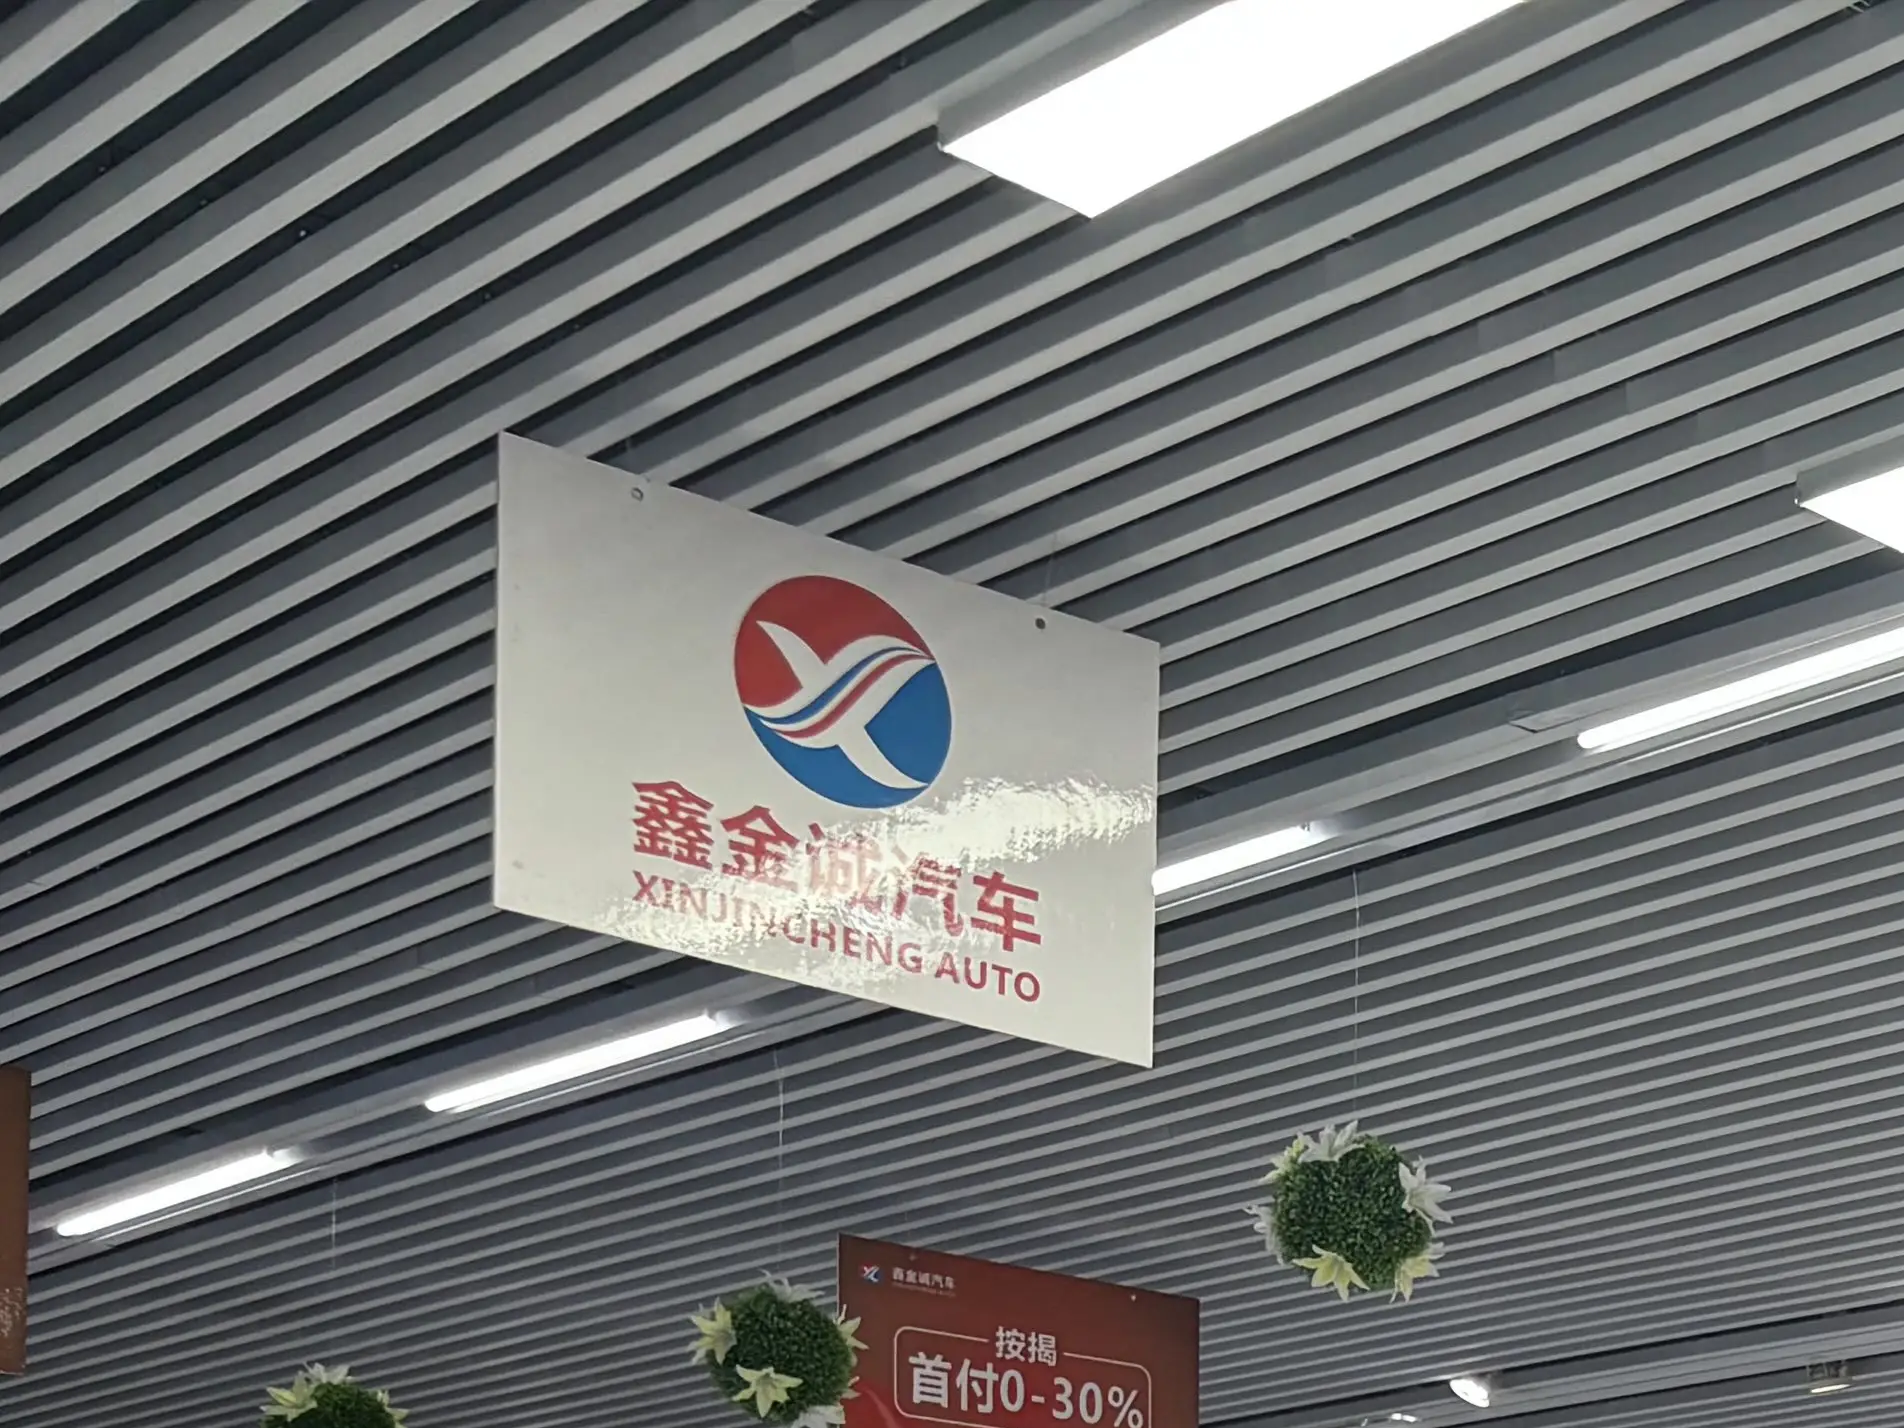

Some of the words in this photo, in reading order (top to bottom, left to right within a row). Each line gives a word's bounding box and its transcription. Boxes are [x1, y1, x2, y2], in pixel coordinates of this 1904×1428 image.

[632, 780, 1042, 953] 鑫金诚汽车
[934, 951, 1041, 1003] AUTO
[995, 1326, 1058, 1367] 按揭
